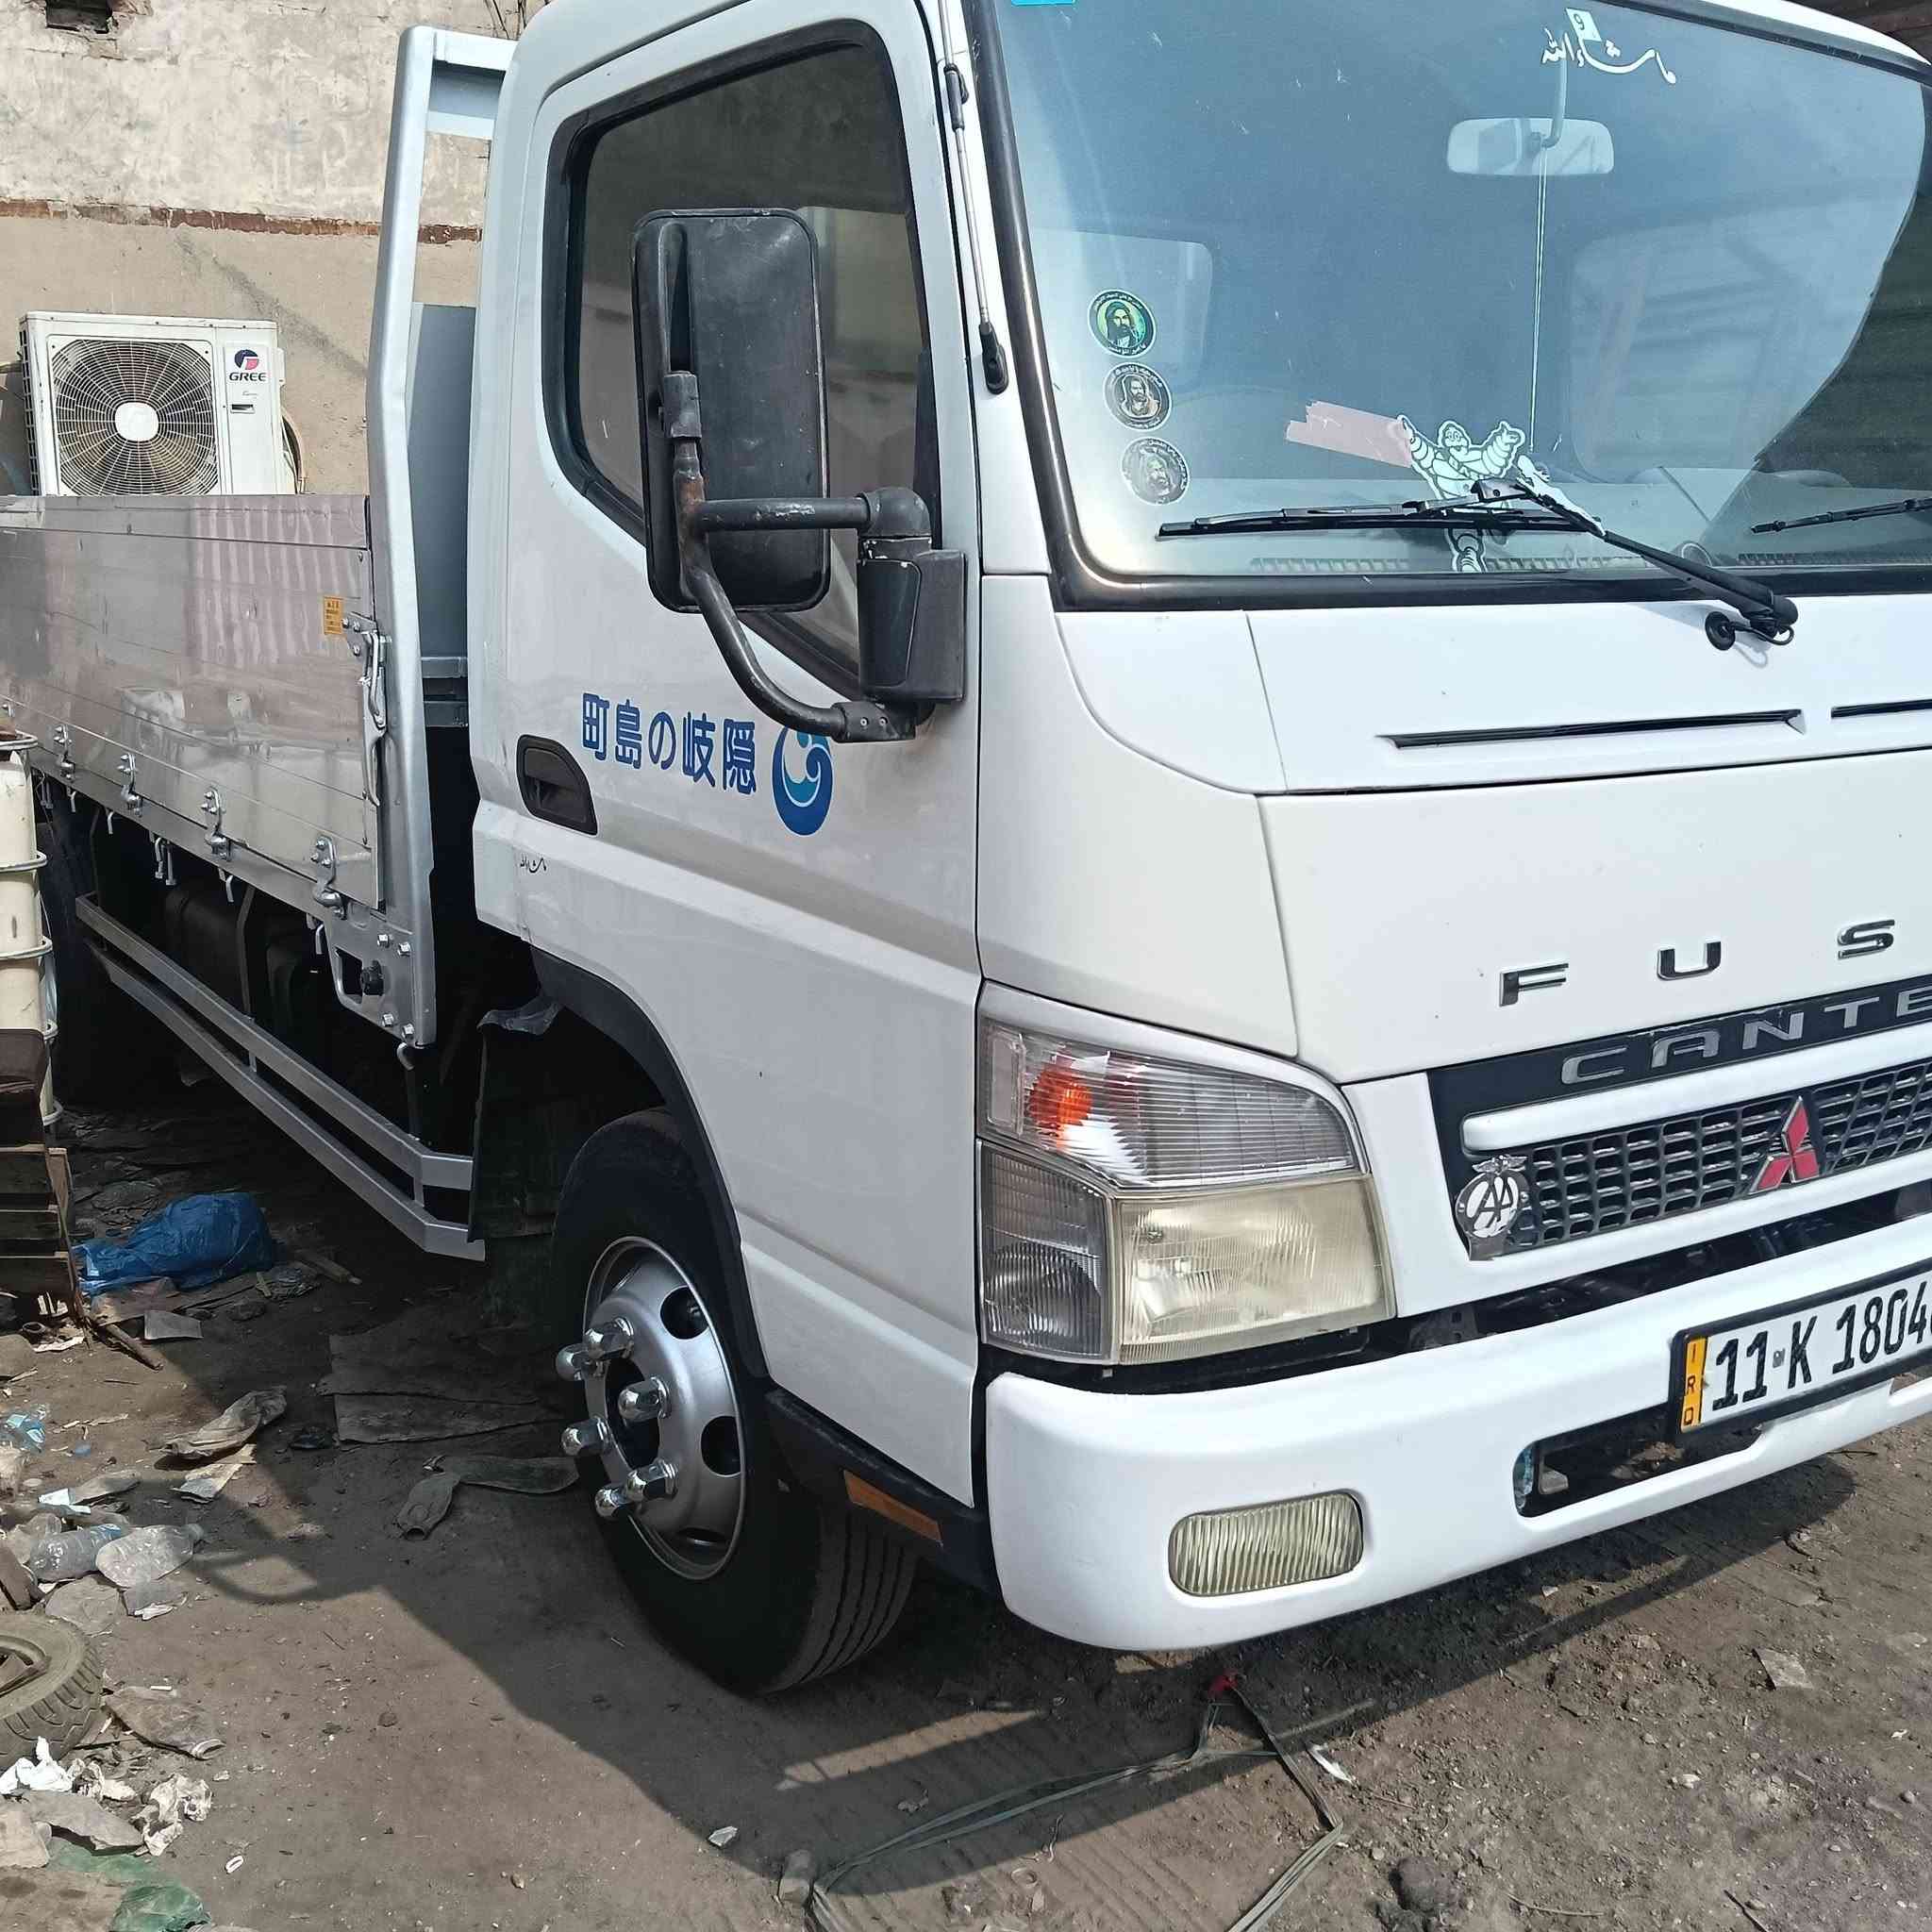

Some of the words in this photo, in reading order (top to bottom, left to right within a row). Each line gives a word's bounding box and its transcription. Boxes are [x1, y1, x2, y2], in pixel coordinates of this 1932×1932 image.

[229, 372, 267, 381] GREE
[1712, 1331, 1769, 1410] 11
[1788, 1315, 1818, 1390] K
[1832, 1281, 1932, 1374] 1804
